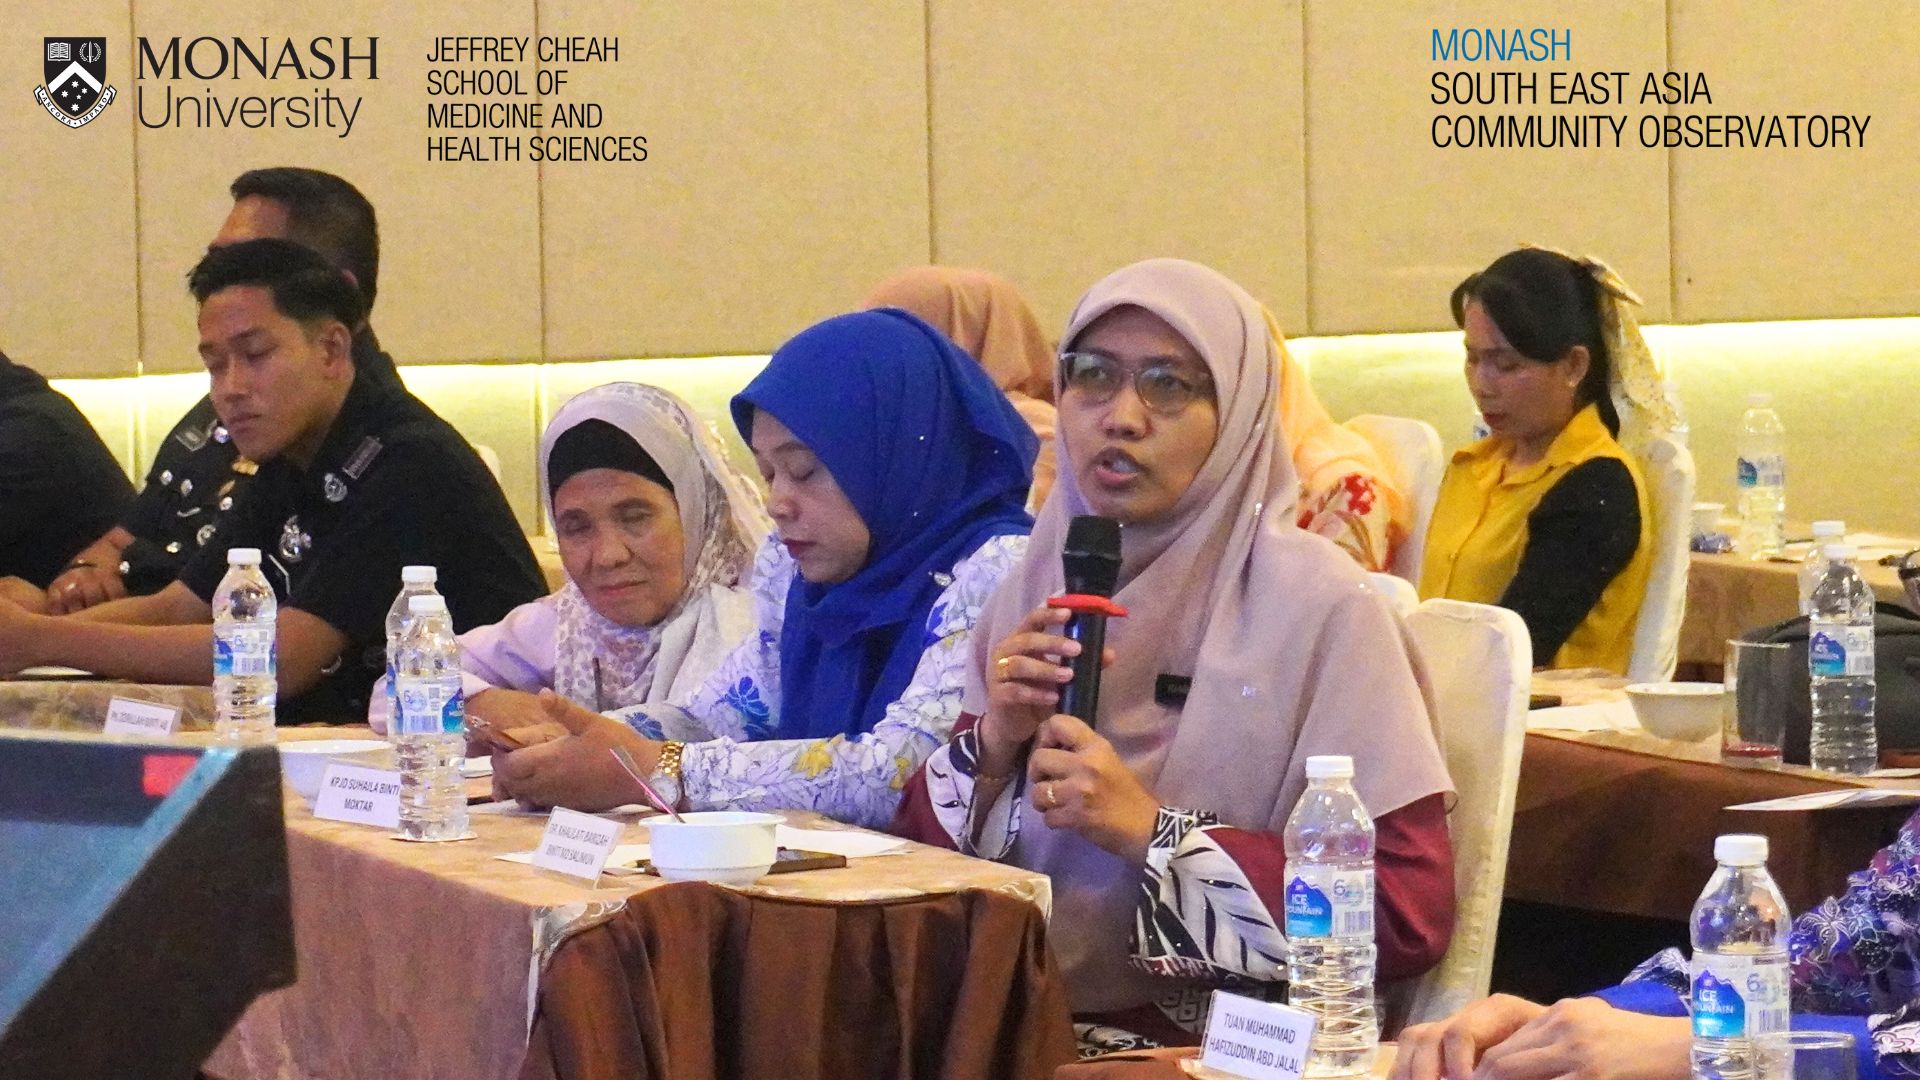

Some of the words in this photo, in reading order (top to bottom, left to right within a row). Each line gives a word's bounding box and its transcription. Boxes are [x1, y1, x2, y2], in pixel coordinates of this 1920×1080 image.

[348, 779, 378, 793] SUHAILA
[379, 783, 400, 796] BINTI
[344, 798, 374, 811] MOKTAR
[1291, 893, 1308, 904] ICE
[1699, 990, 1717, 1002] ICE
[1224, 1013, 1245, 1030] TUAN
[1245, 1019, 1297, 1044] MUHAMMAD
[1209, 1037, 1257, 1062] HAFIZUDDIN
[1256, 1047, 1274, 1066] ABD
[1274, 1055, 1299, 1074] JALAL
